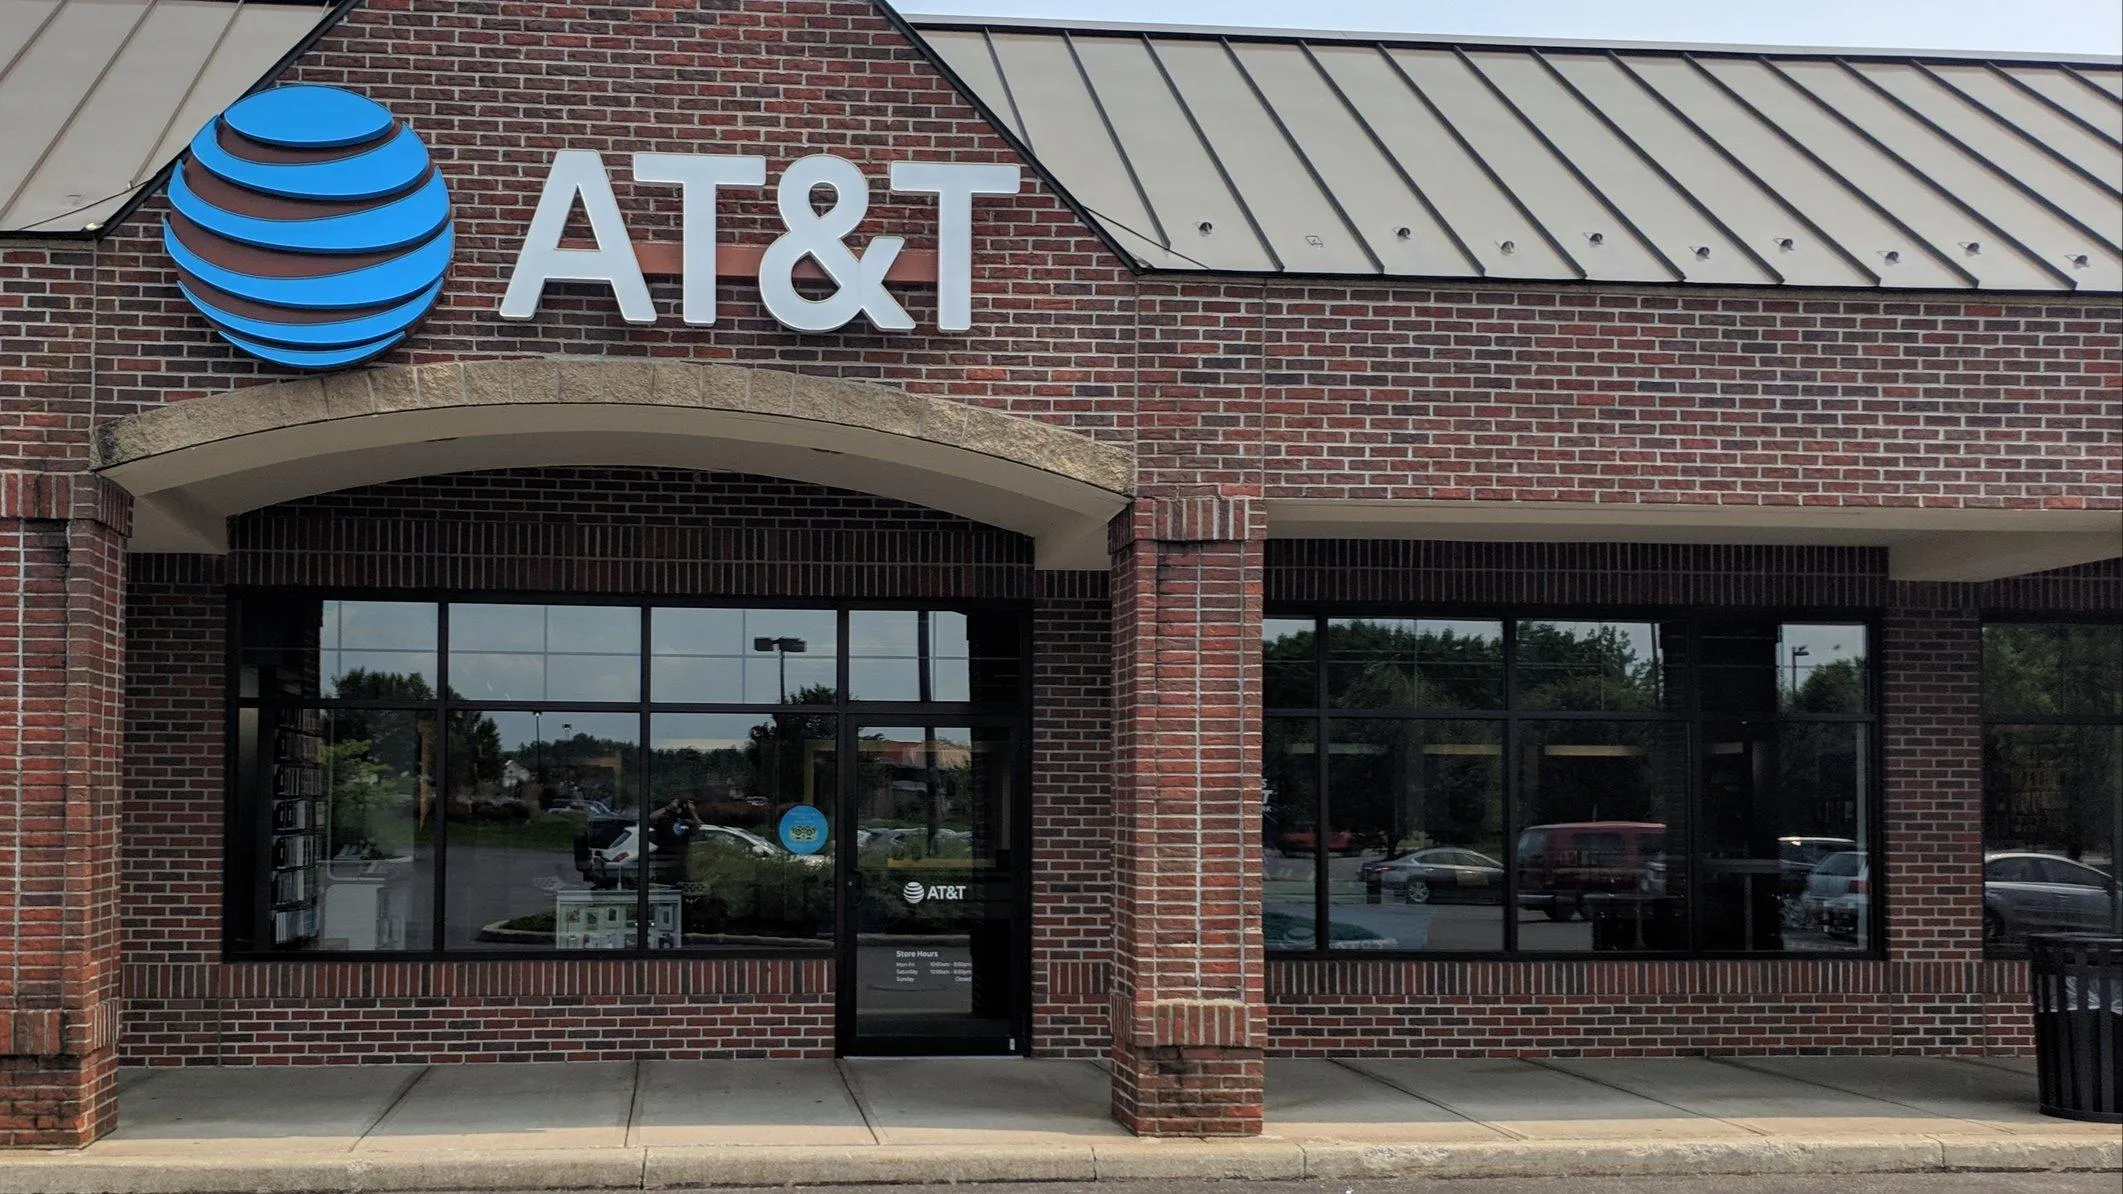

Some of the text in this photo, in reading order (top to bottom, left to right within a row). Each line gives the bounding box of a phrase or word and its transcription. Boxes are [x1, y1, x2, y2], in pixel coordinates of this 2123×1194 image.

[499, 148, 1021, 333] AT&T
[927, 885, 967, 900] AT&T
[896, 950, 939, 958] Store Hours
